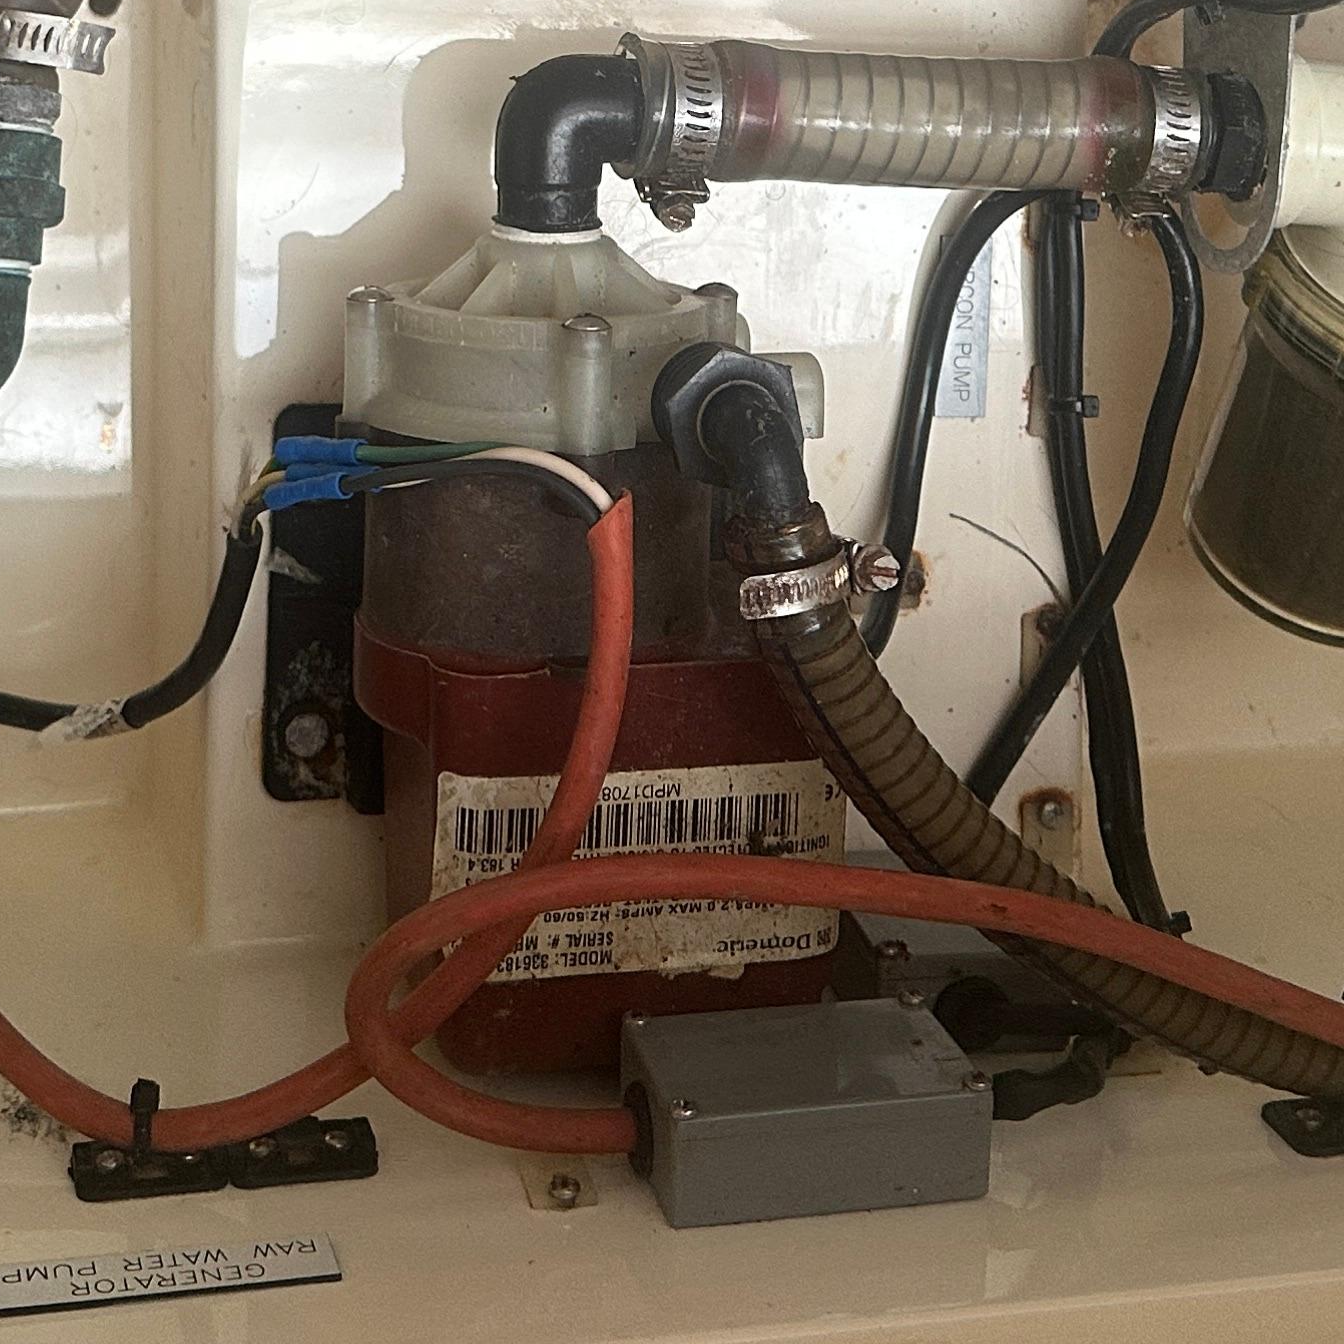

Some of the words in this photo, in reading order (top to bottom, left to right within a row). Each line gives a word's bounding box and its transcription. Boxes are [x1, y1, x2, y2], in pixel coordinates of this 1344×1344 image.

[952, 343, 973, 402] PUMP
[775, 835, 830, 854] IGNITIO
[668, 902, 701, 915] MAX
[564, 931, 614, 949] SERIAL
[715, 933, 812, 955] Dometic
[555, 949, 613, 967] MODEL:
[251, 1238, 317, 1260] RAW
[121, 1248, 228, 1273] WATER
[1, 1260, 97, 1284] PUMP
[69, 1262, 266, 1297] GENERATOR
